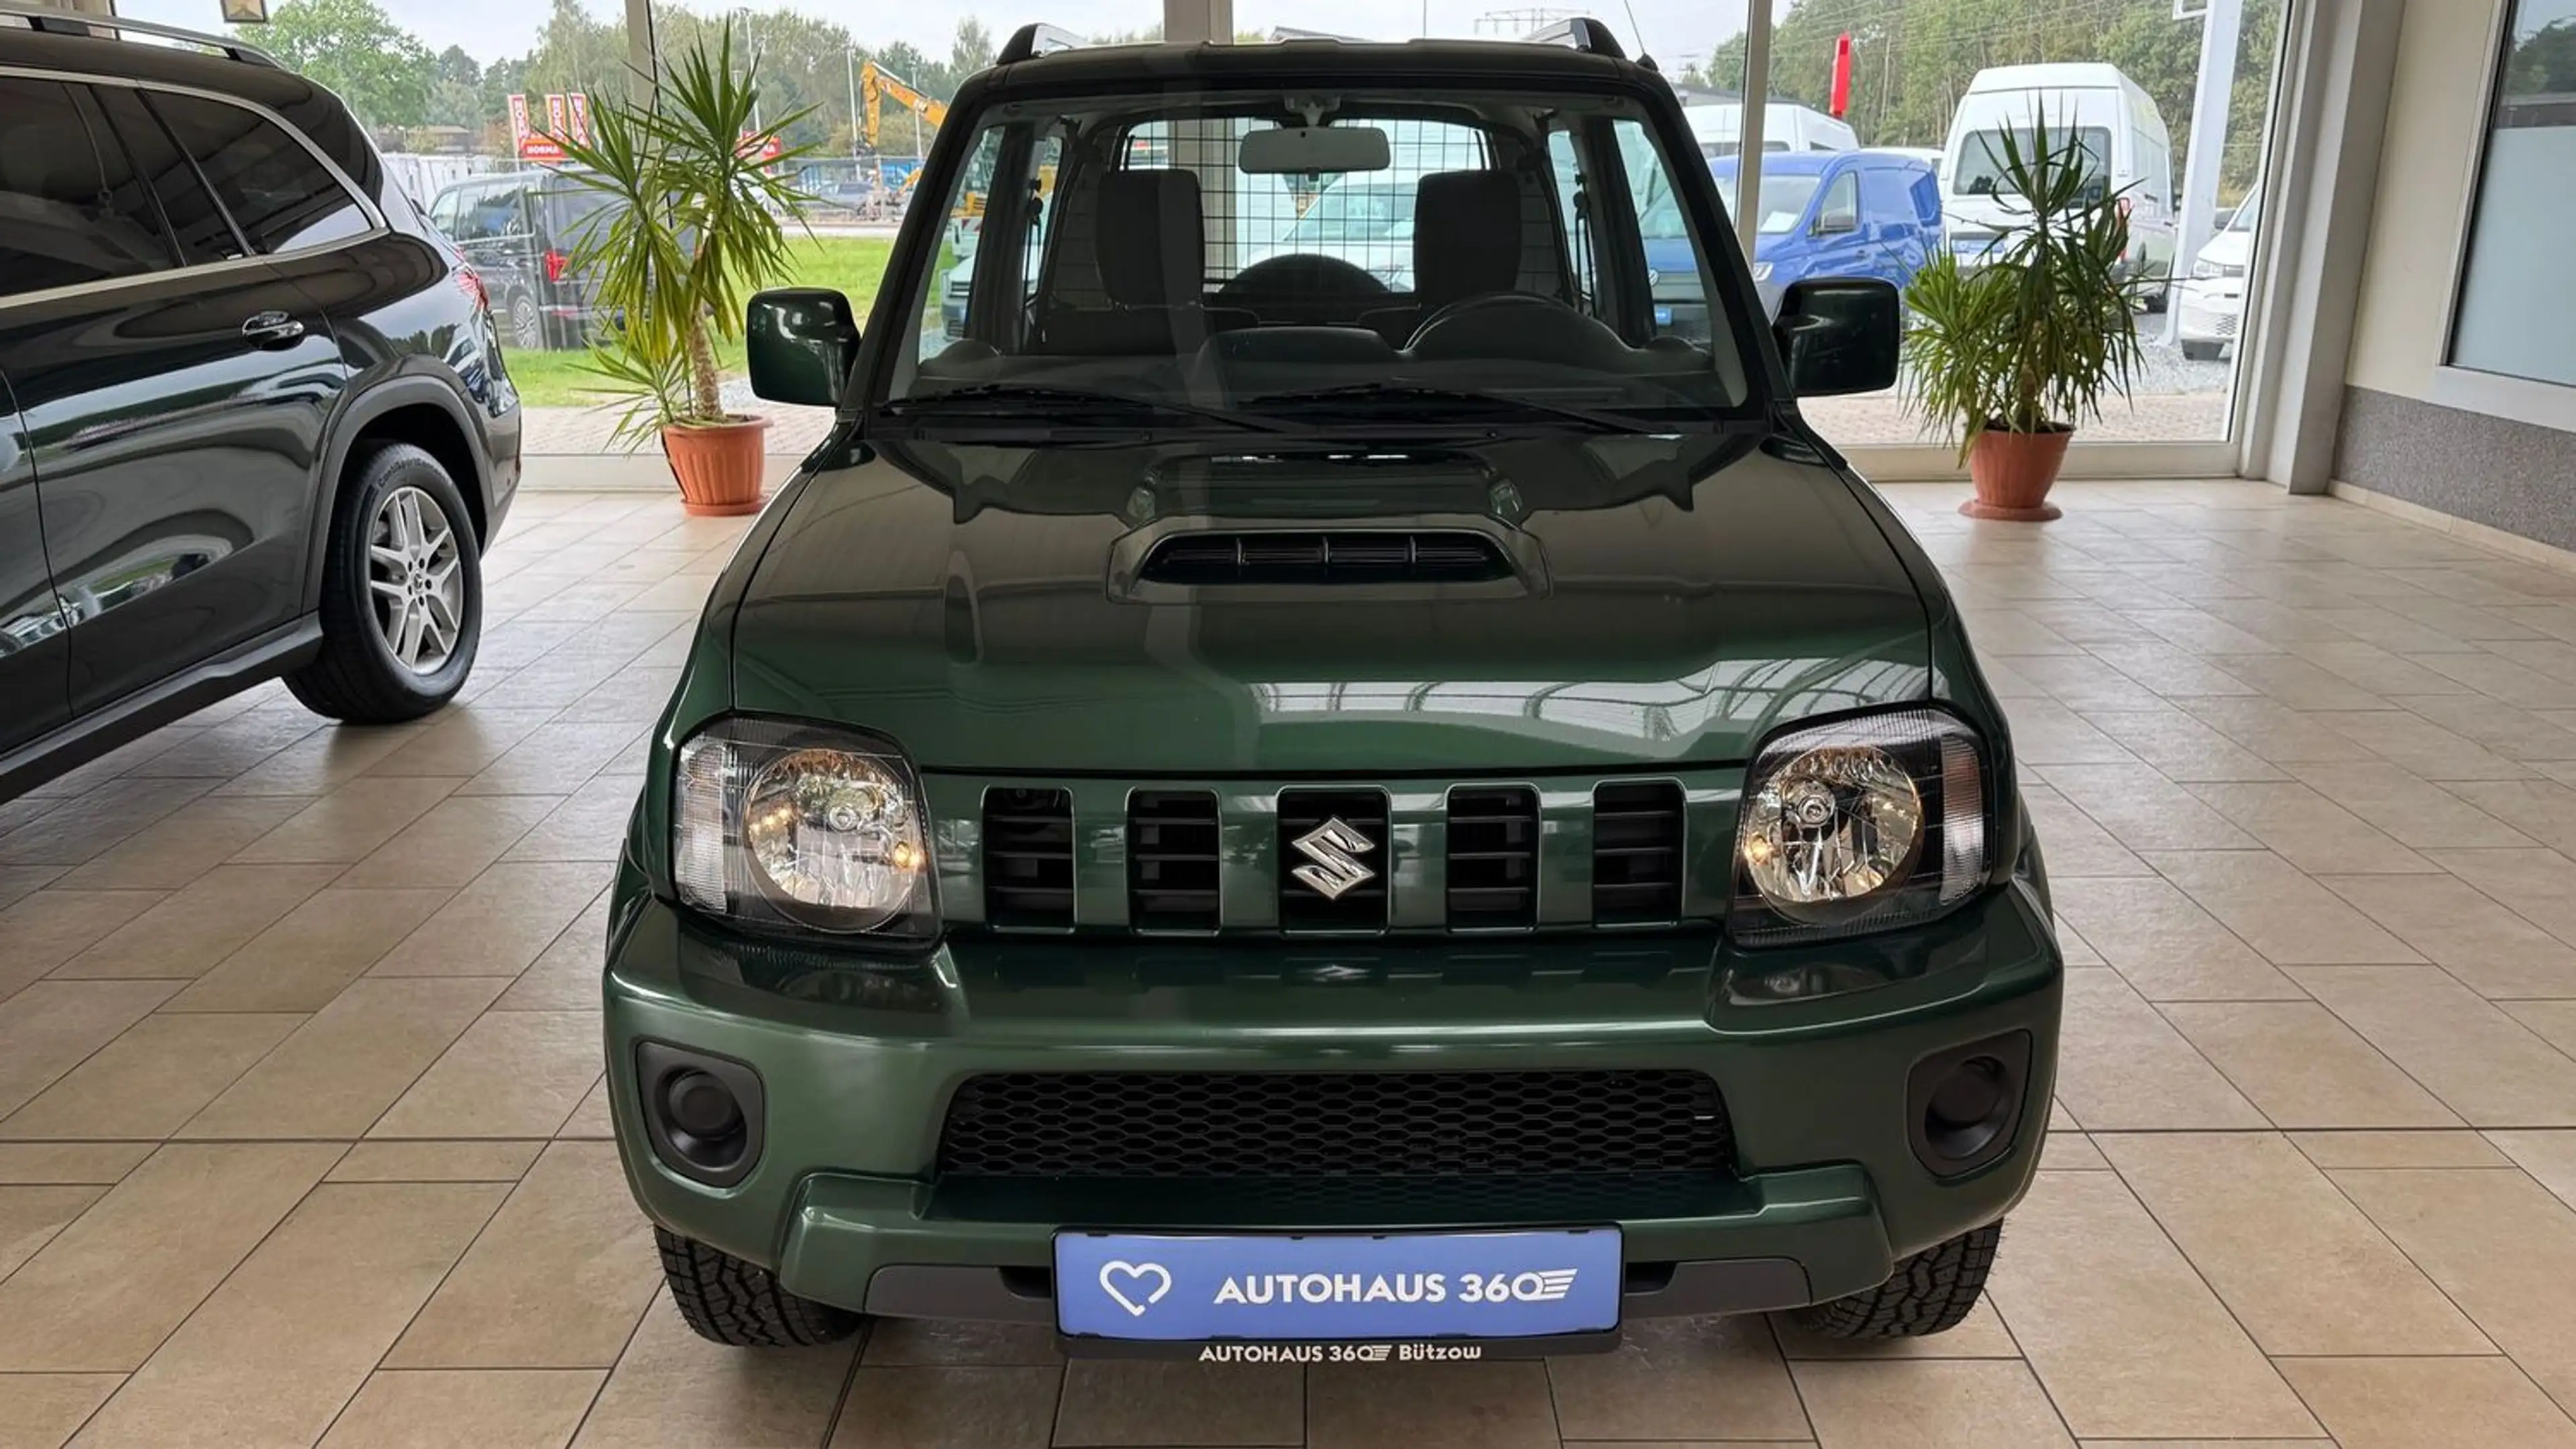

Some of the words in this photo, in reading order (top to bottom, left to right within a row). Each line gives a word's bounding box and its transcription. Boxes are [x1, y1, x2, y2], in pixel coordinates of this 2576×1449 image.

[1213, 1273, 1447, 1305] AUTOHAUS
[1198, 1344, 1324, 1362] AUTOHAUS
[1398, 1342, 1482, 1362] Bützow
